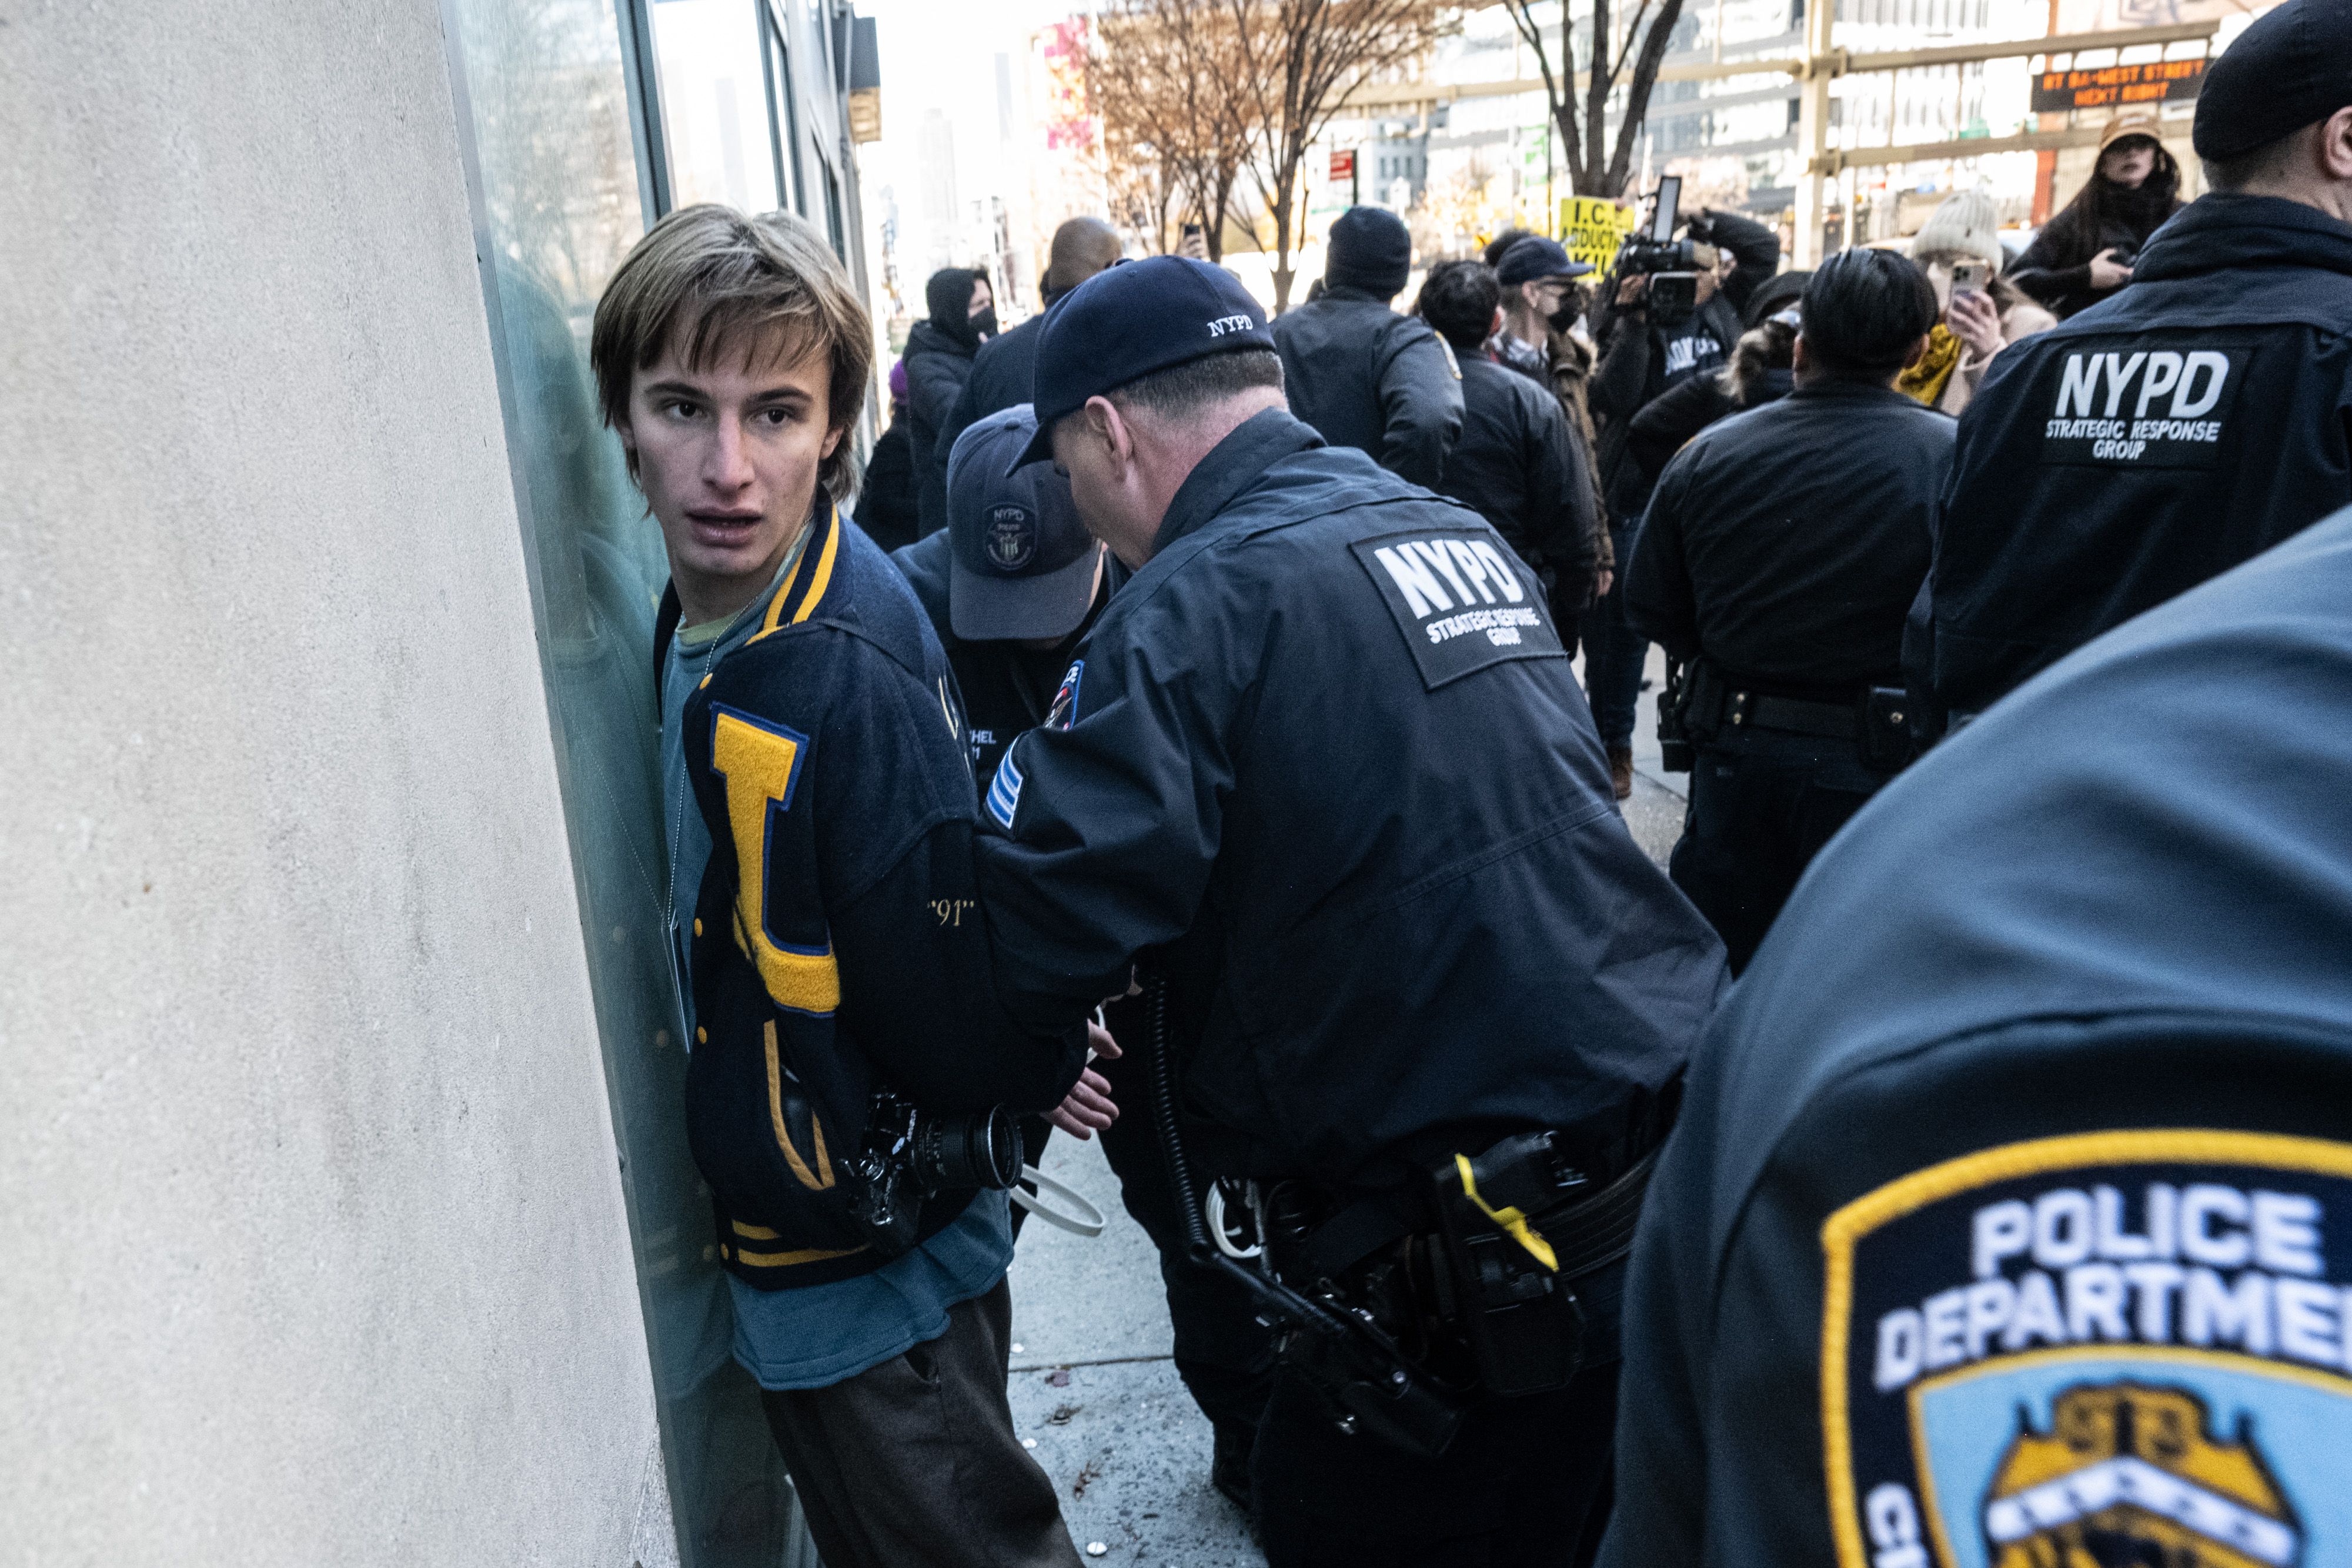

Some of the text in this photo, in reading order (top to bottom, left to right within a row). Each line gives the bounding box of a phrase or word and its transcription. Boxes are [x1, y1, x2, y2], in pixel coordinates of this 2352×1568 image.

[1207, 315, 1253, 337] NYPD
[2055, 351, 2230, 418] NYPD
[2045, 419, 2221, 442] STRATEGIC RESPONSE
[2093, 440, 2146, 459] GROUP
[1374, 540, 1524, 619] NYPD
[970, 729, 997, 744] HEL
[1972, 1182, 2326, 1278] POLICE
[1875, 1263, 2352, 1392] DEPARTME
